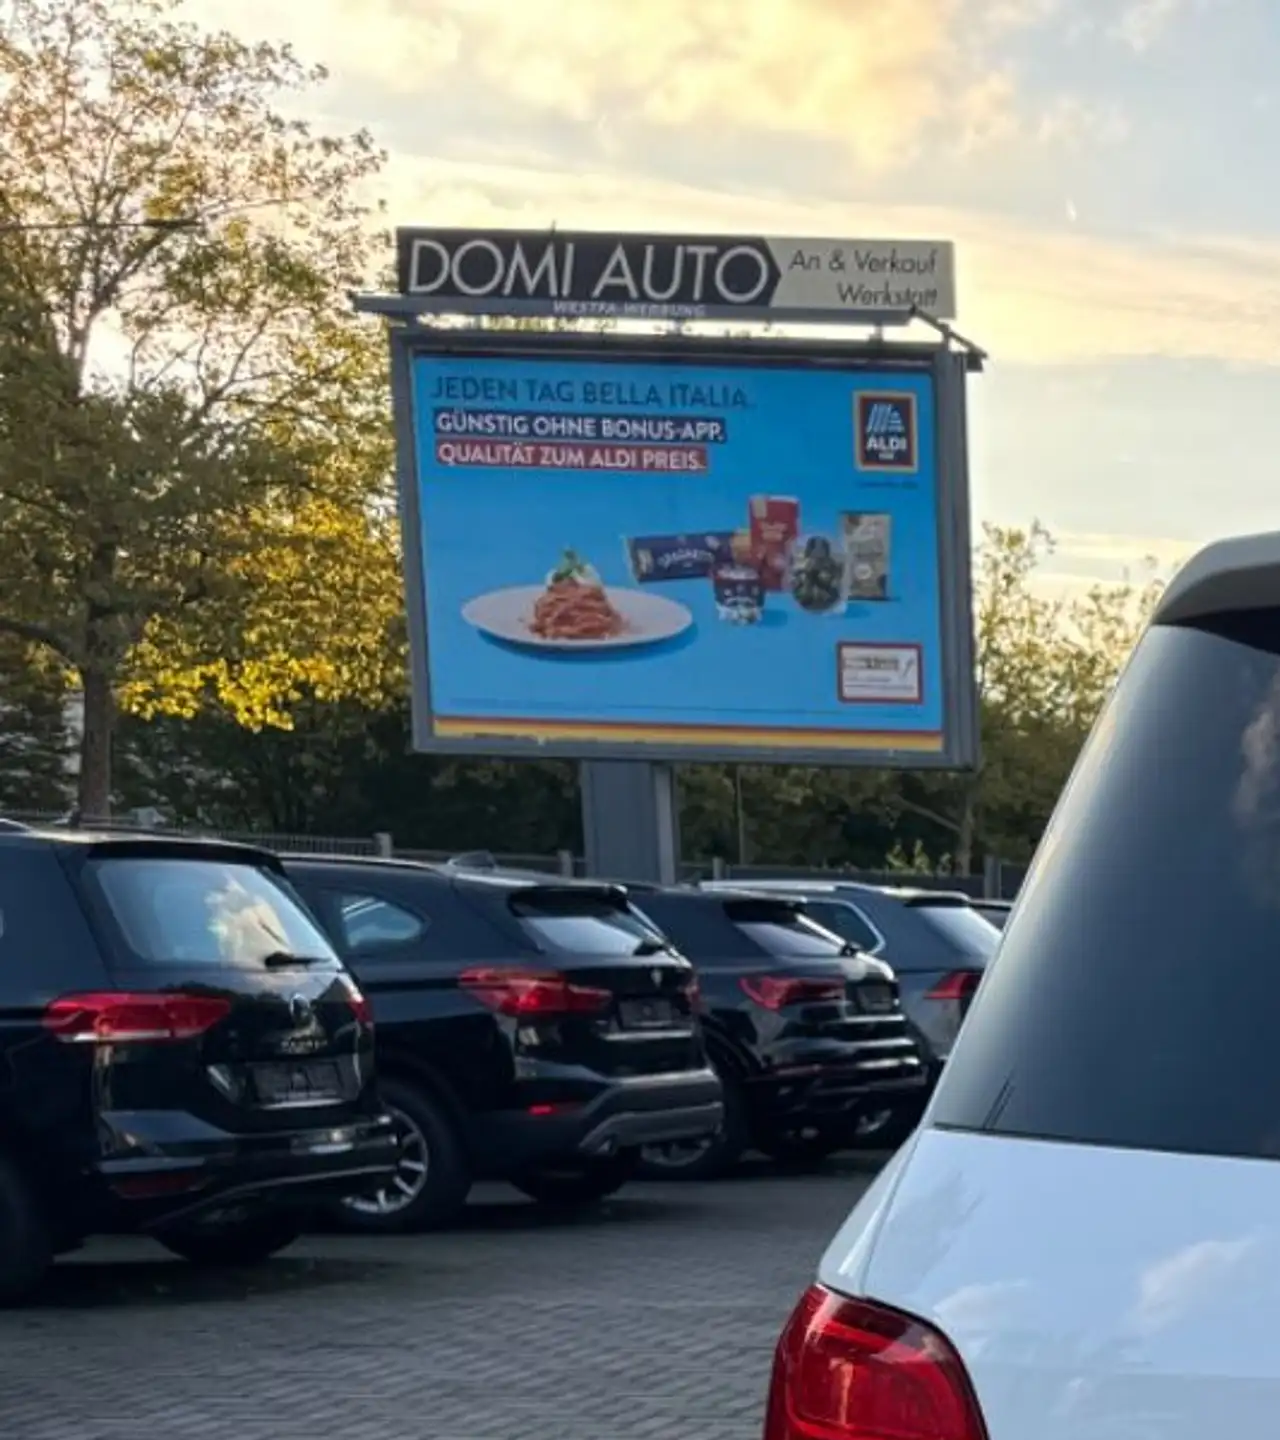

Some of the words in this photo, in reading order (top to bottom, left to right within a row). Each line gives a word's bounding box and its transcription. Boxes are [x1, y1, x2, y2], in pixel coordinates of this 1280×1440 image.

[408, 239, 575, 297] DOMI
[591, 243, 769, 304] AUTO
[788, 248, 821, 271] An
[829, 249, 845, 272] &
[854, 249, 937, 274] Verkauf
[836, 280, 938, 307] Werkstatt
[431, 376, 518, 402] JEDEN
[523, 378, 574, 403] TAG
[582, 380, 662, 408] BELLA
[436, 408, 529, 435] GÜNSTIG
[532, 416, 597, 437] OHNE
[601, 417, 725, 441] BONUS-APP.
[437, 441, 536, 466] QUALITÄT
[539, 445, 585, 468] ZUM
[588, 448, 637, 469] ALDI
[643, 450, 706, 470] PREIS.
[866, 436, 909, 452] ALDI
